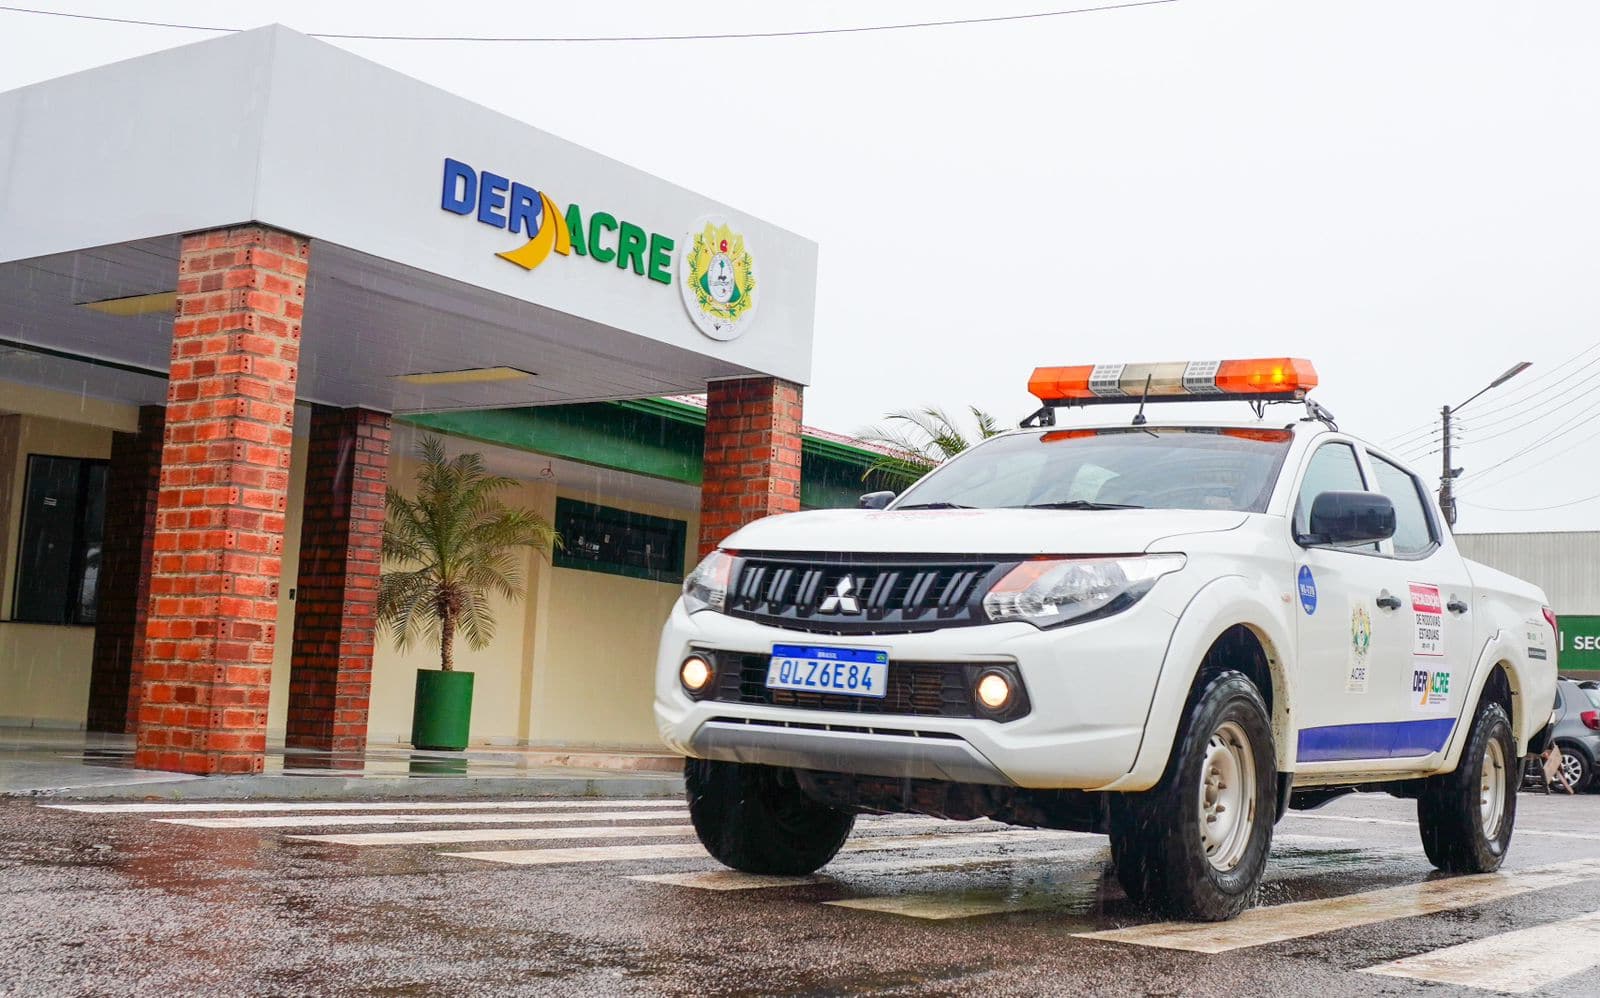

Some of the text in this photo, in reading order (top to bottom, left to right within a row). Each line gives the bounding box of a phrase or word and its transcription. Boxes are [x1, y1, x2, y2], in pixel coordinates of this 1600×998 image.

[441, 157, 675, 285] DER ACRE
[779, 660, 872, 690] QLZ6E84
[1413, 670, 1450, 693] DER ACRE
